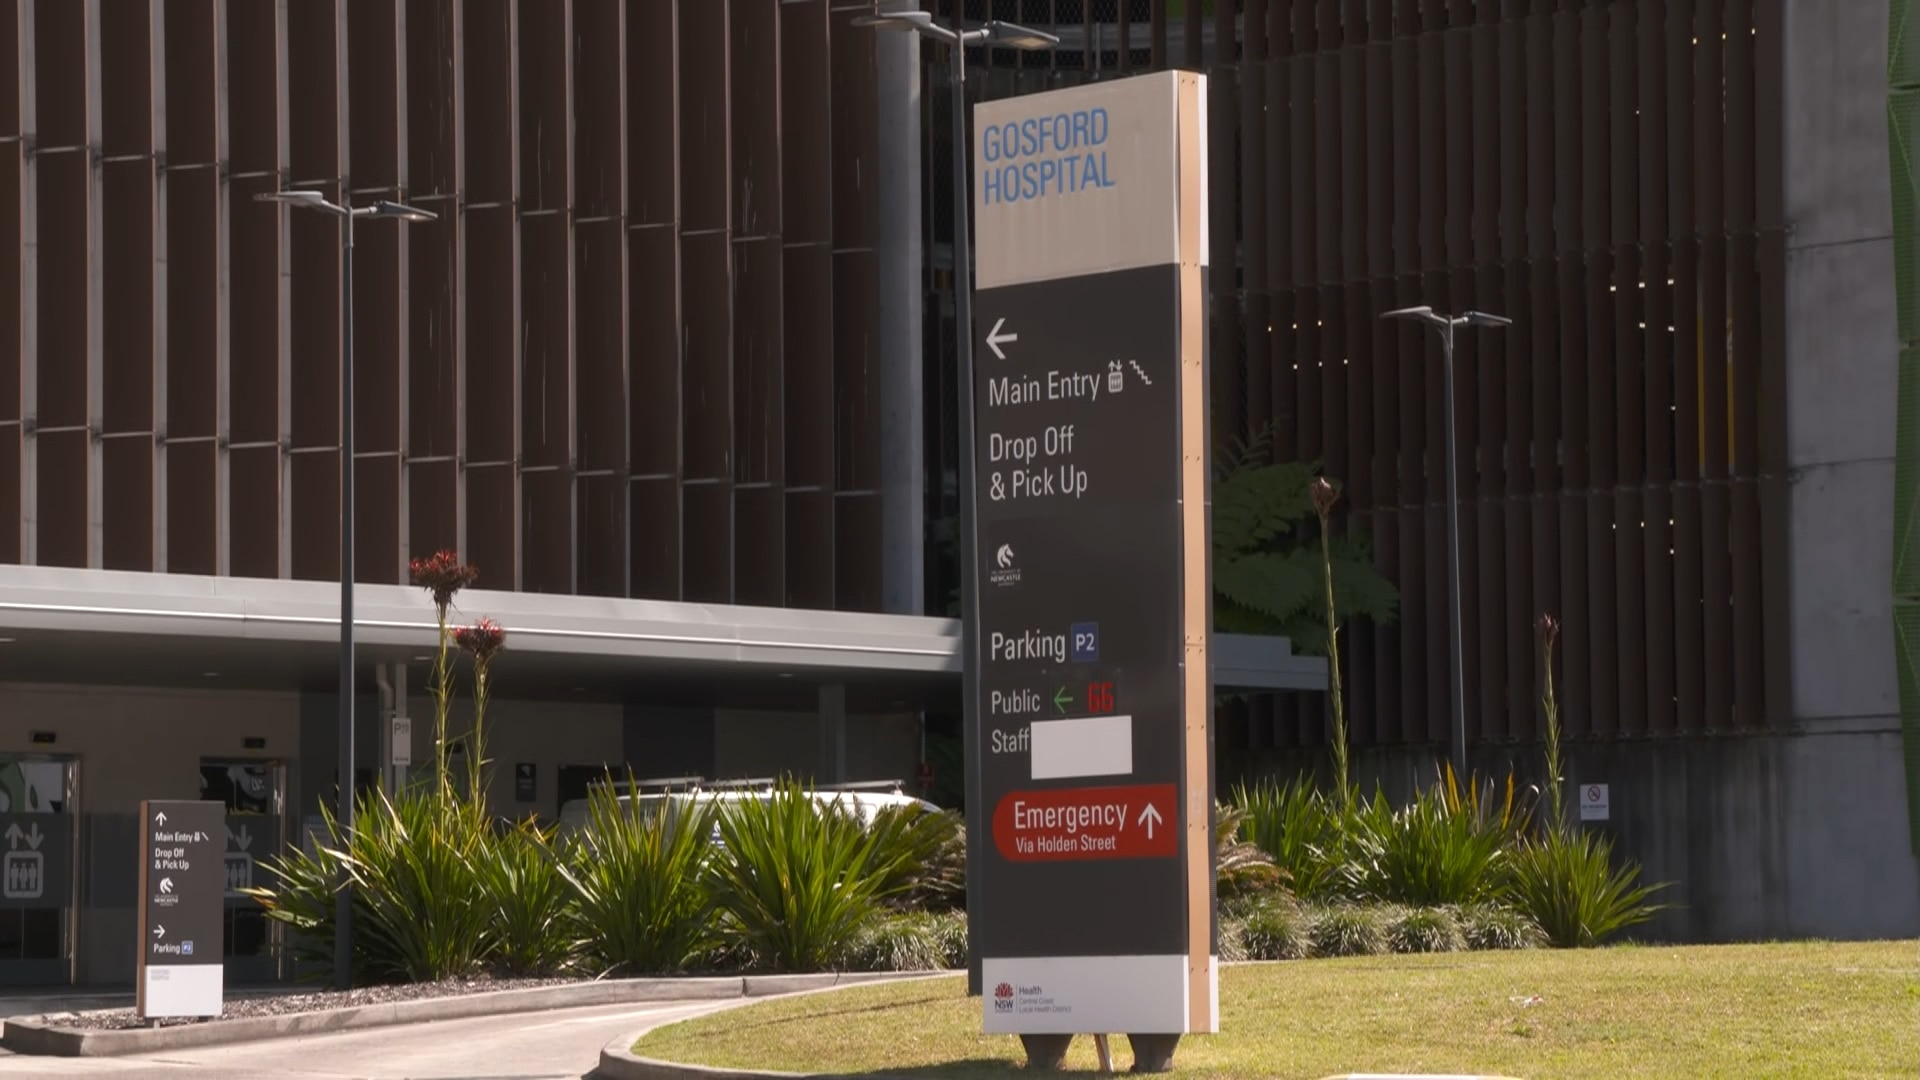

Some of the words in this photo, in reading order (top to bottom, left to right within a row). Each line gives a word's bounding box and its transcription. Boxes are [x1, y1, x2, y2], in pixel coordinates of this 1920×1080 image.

[983, 107, 1109, 163] GOSFORD
[984, 151, 1116, 206] HOSPITAL
[989, 374, 1041, 407] Main
[1048, 370, 1101, 402] Entry
[990, 432, 1037, 464] Drop
[1044, 424, 1075, 456] Off
[990, 471, 1006, 501] &
[1012, 467, 1055, 499] Pick
[1060, 464, 1088, 499] Up
[991, 629, 1066, 663] Parking
[1075, 632, 1096, 652] P2
[991, 688, 1041, 715] Public
[991, 727, 1030, 754] Staff
[1014, 800, 1128, 834] Emergency
[155, 832, 173, 842] Main
[174, 832, 193, 844] Entry
[1016, 837, 1034, 854] Via
[1037, 835, 1078, 853] Holden
[1081, 834, 1117, 851] Street
[155, 848, 172, 859] Drop
[173, 848, 184, 858] Off
[155, 860, 161, 870] &
[162, 859, 178, 870] Pick
[179, 860, 189, 871] Up
[153, 943, 181, 955] Parking
[1019, 985, 1042, 995] Health
[995, 999, 1013, 1009] NSW
